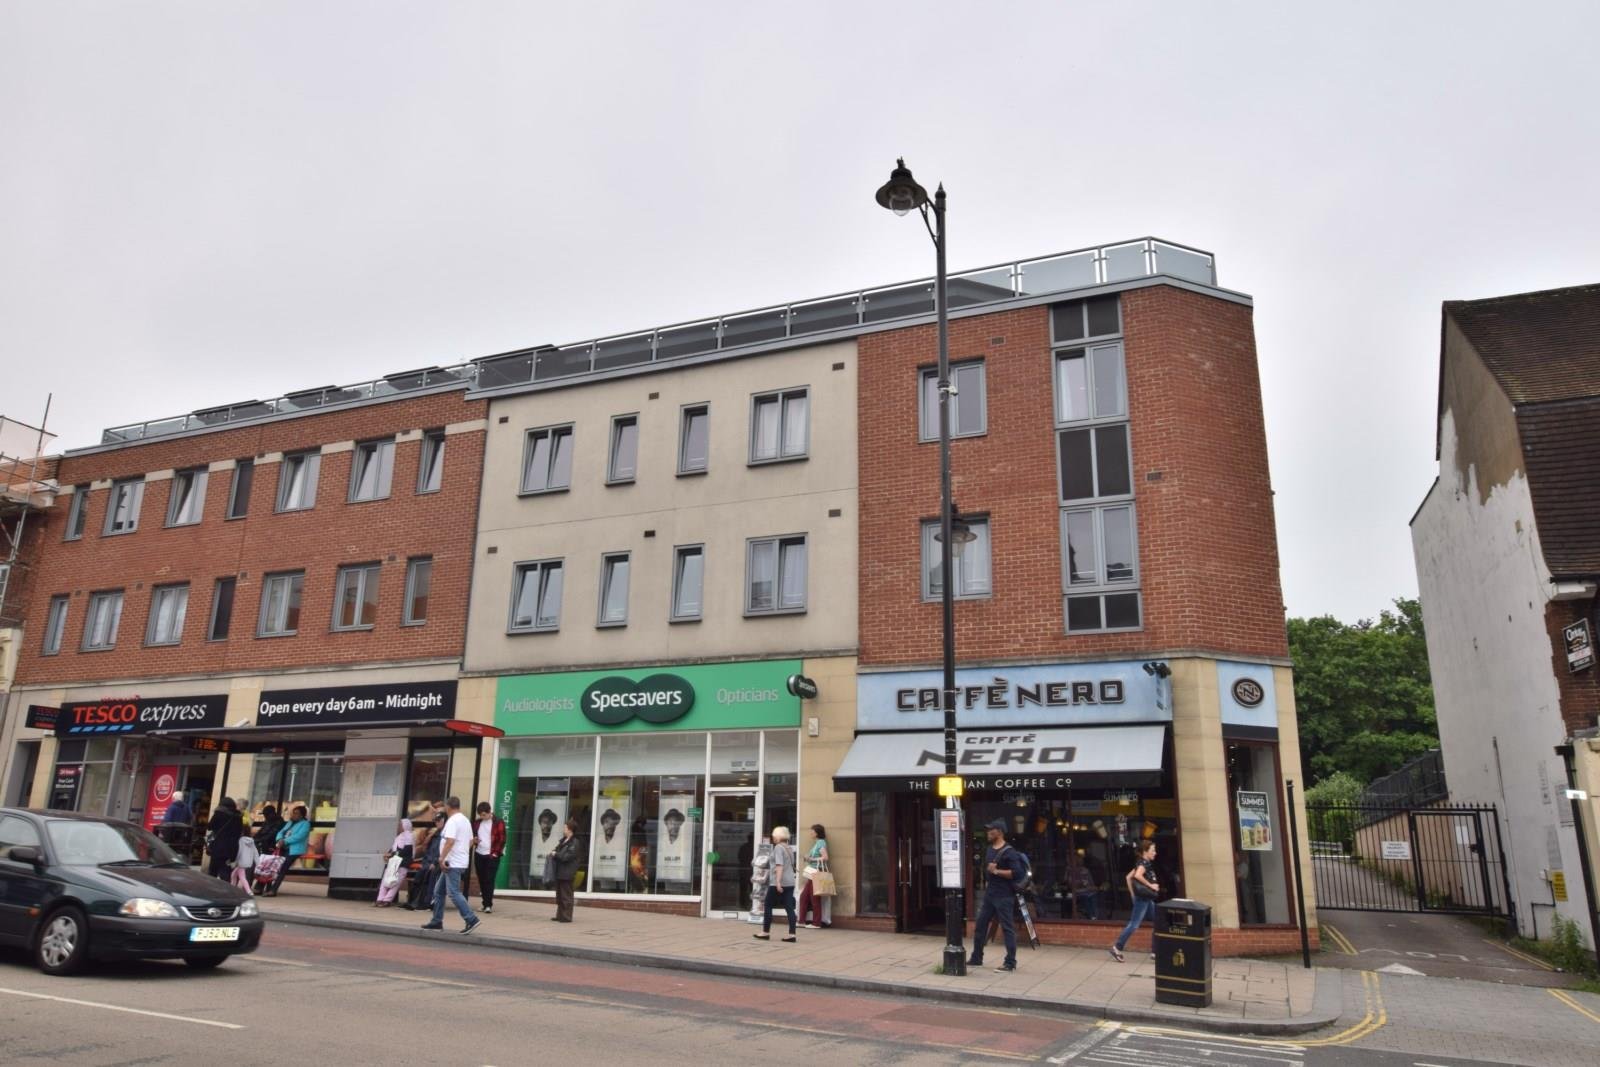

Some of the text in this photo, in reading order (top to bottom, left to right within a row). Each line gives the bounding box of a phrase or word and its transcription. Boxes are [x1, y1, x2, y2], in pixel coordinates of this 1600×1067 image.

[590, 690, 682, 712] Specsavers
[717, 687, 779, 705] Opticians
[897, 677, 1125, 711] CAFÈ NERO
[259, 701, 290, 717] Open
[292, 700, 325, 715] every
[387, 693, 443, 710] Midnight
[503, 697, 575, 713] Audiologists
[73, 705, 137, 725] TESCO
[141, 704, 207, 729] express
[917, 747, 1077, 766] NERO
[910, 781, 930, 790] THE
[995, 779, 1046, 789] COFFEE
[1241, 797, 1265, 807] SUMMER
